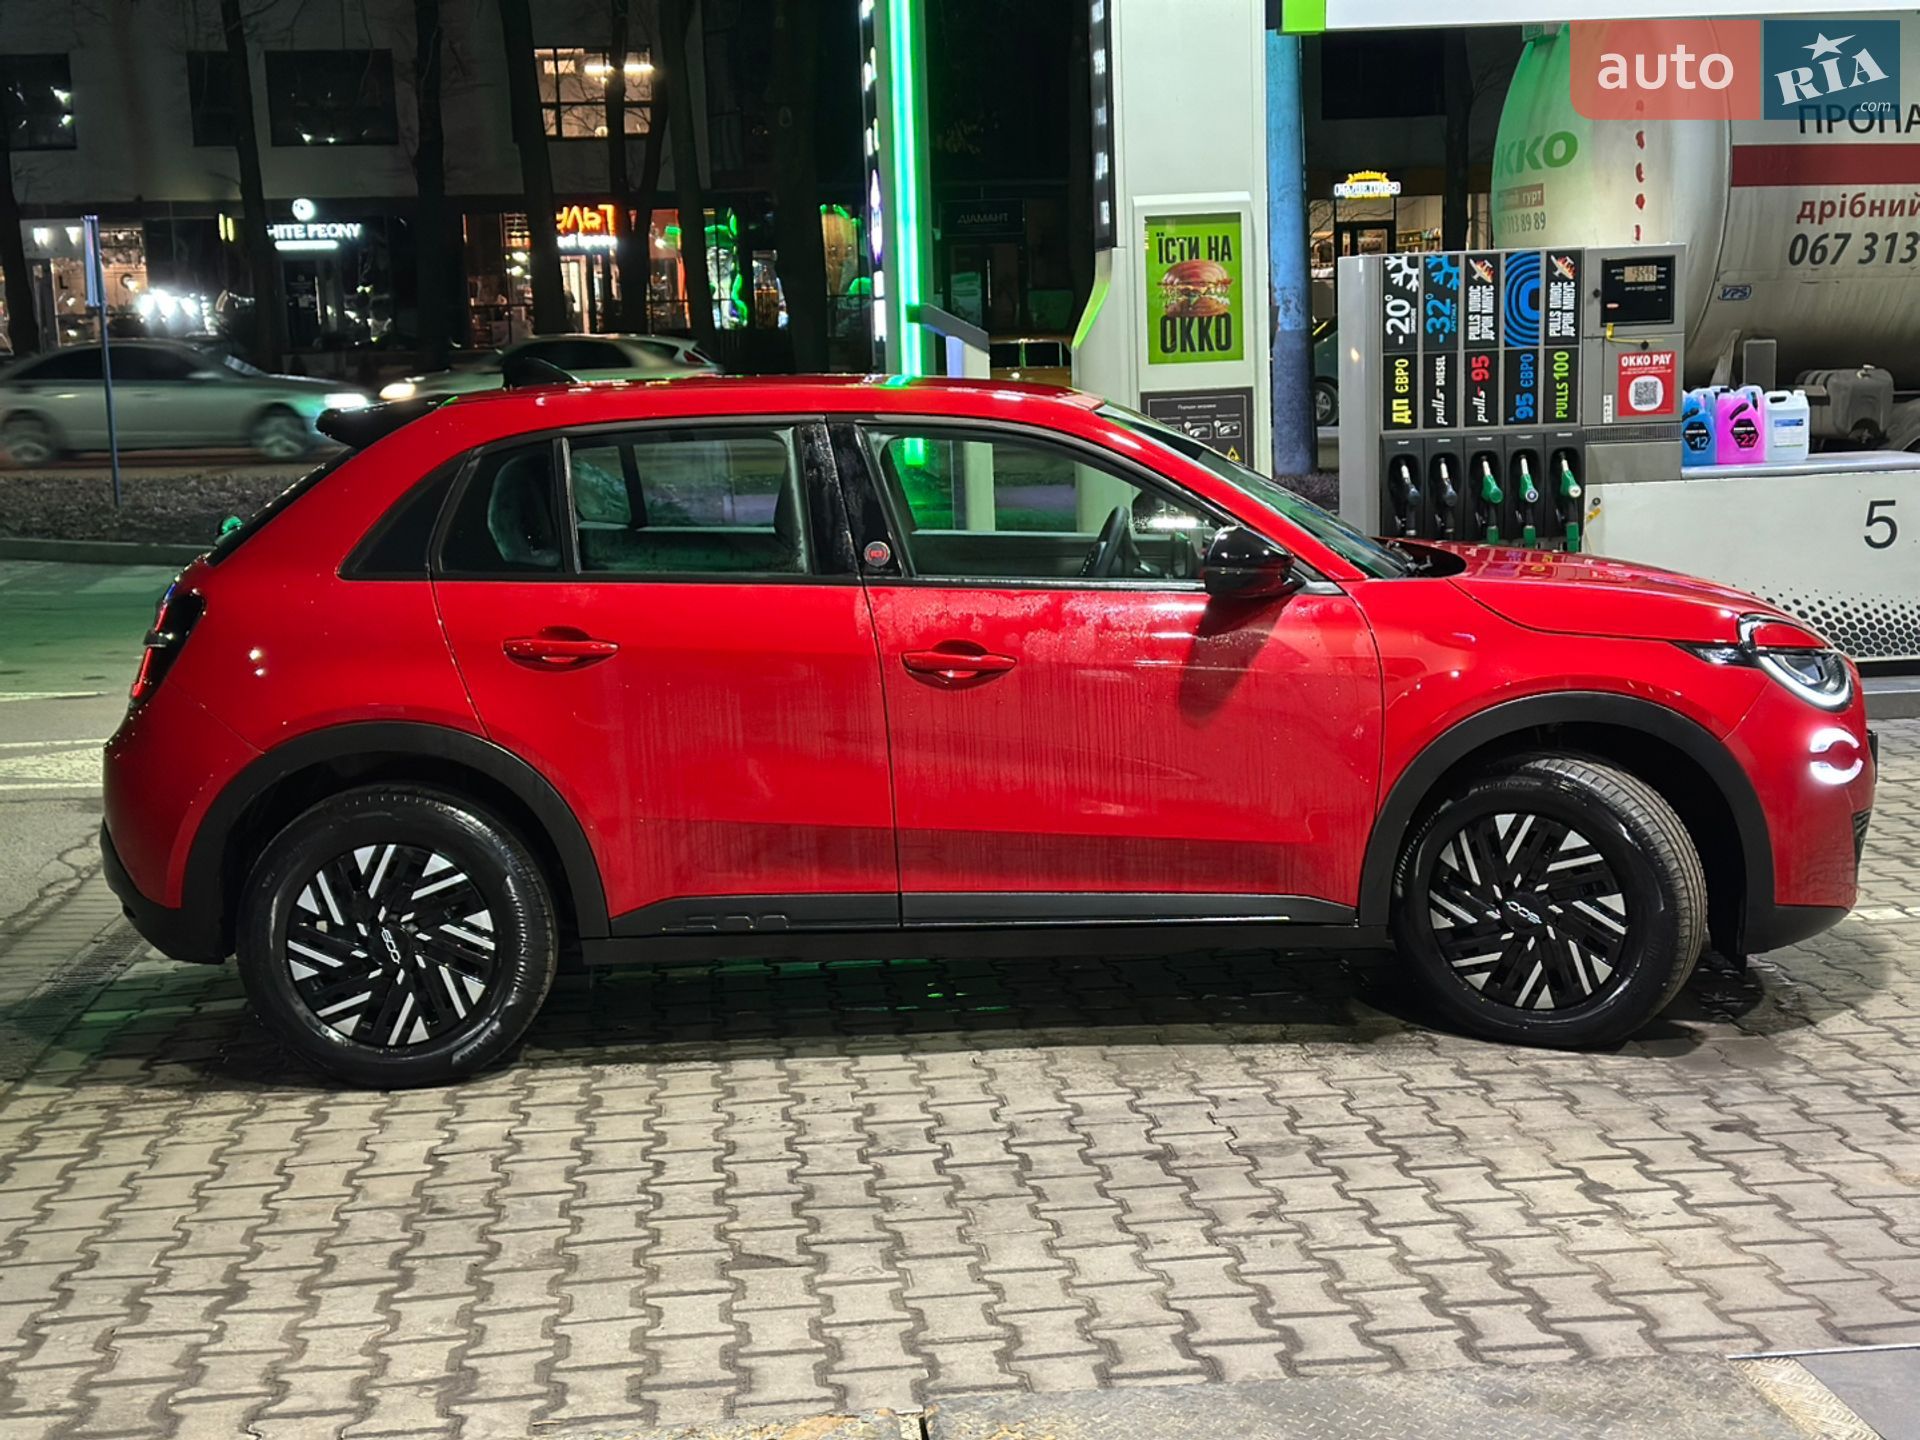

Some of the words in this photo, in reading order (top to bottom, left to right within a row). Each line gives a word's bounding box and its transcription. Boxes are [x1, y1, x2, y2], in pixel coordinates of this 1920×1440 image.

[1496, 131, 1578, 177] KKO
[267, 223, 306, 239] HITE
[306, 223, 362, 240] PEONY
[1521, 212, 1532, 232] 89
[1534, 211, 1546, 231] 89
[1156, 231, 1200, 264] ЇСТИ
[1208, 235, 1232, 262] НА
[1788, 232, 1852, 266] 067
[1857, 231, 1920, 265] 313
[1468, 314, 1481, 341] PULLS
[1549, 310, 1562, 337] PULLS
[1395, 358, 1409, 393] ЄВРО
[1436, 355, 1446, 386] DIESEL
[1471, 355, 1490, 382] 95
[1520, 353, 1534, 388] ЄВРО
[1553, 351, 1569, 380] 100
[1621, 354, 1651, 367] OKKO
[1652, 353, 1672, 366] PAY
[1392, 398, 1412, 424] ДП
[1432, 389, 1448, 426] pulls
[1472, 387, 1489, 423] pulls
[1515, 392, 1534, 419] 95
[1555, 382, 1569, 419] PULLS
[1864, 499, 1897, 549] 5
